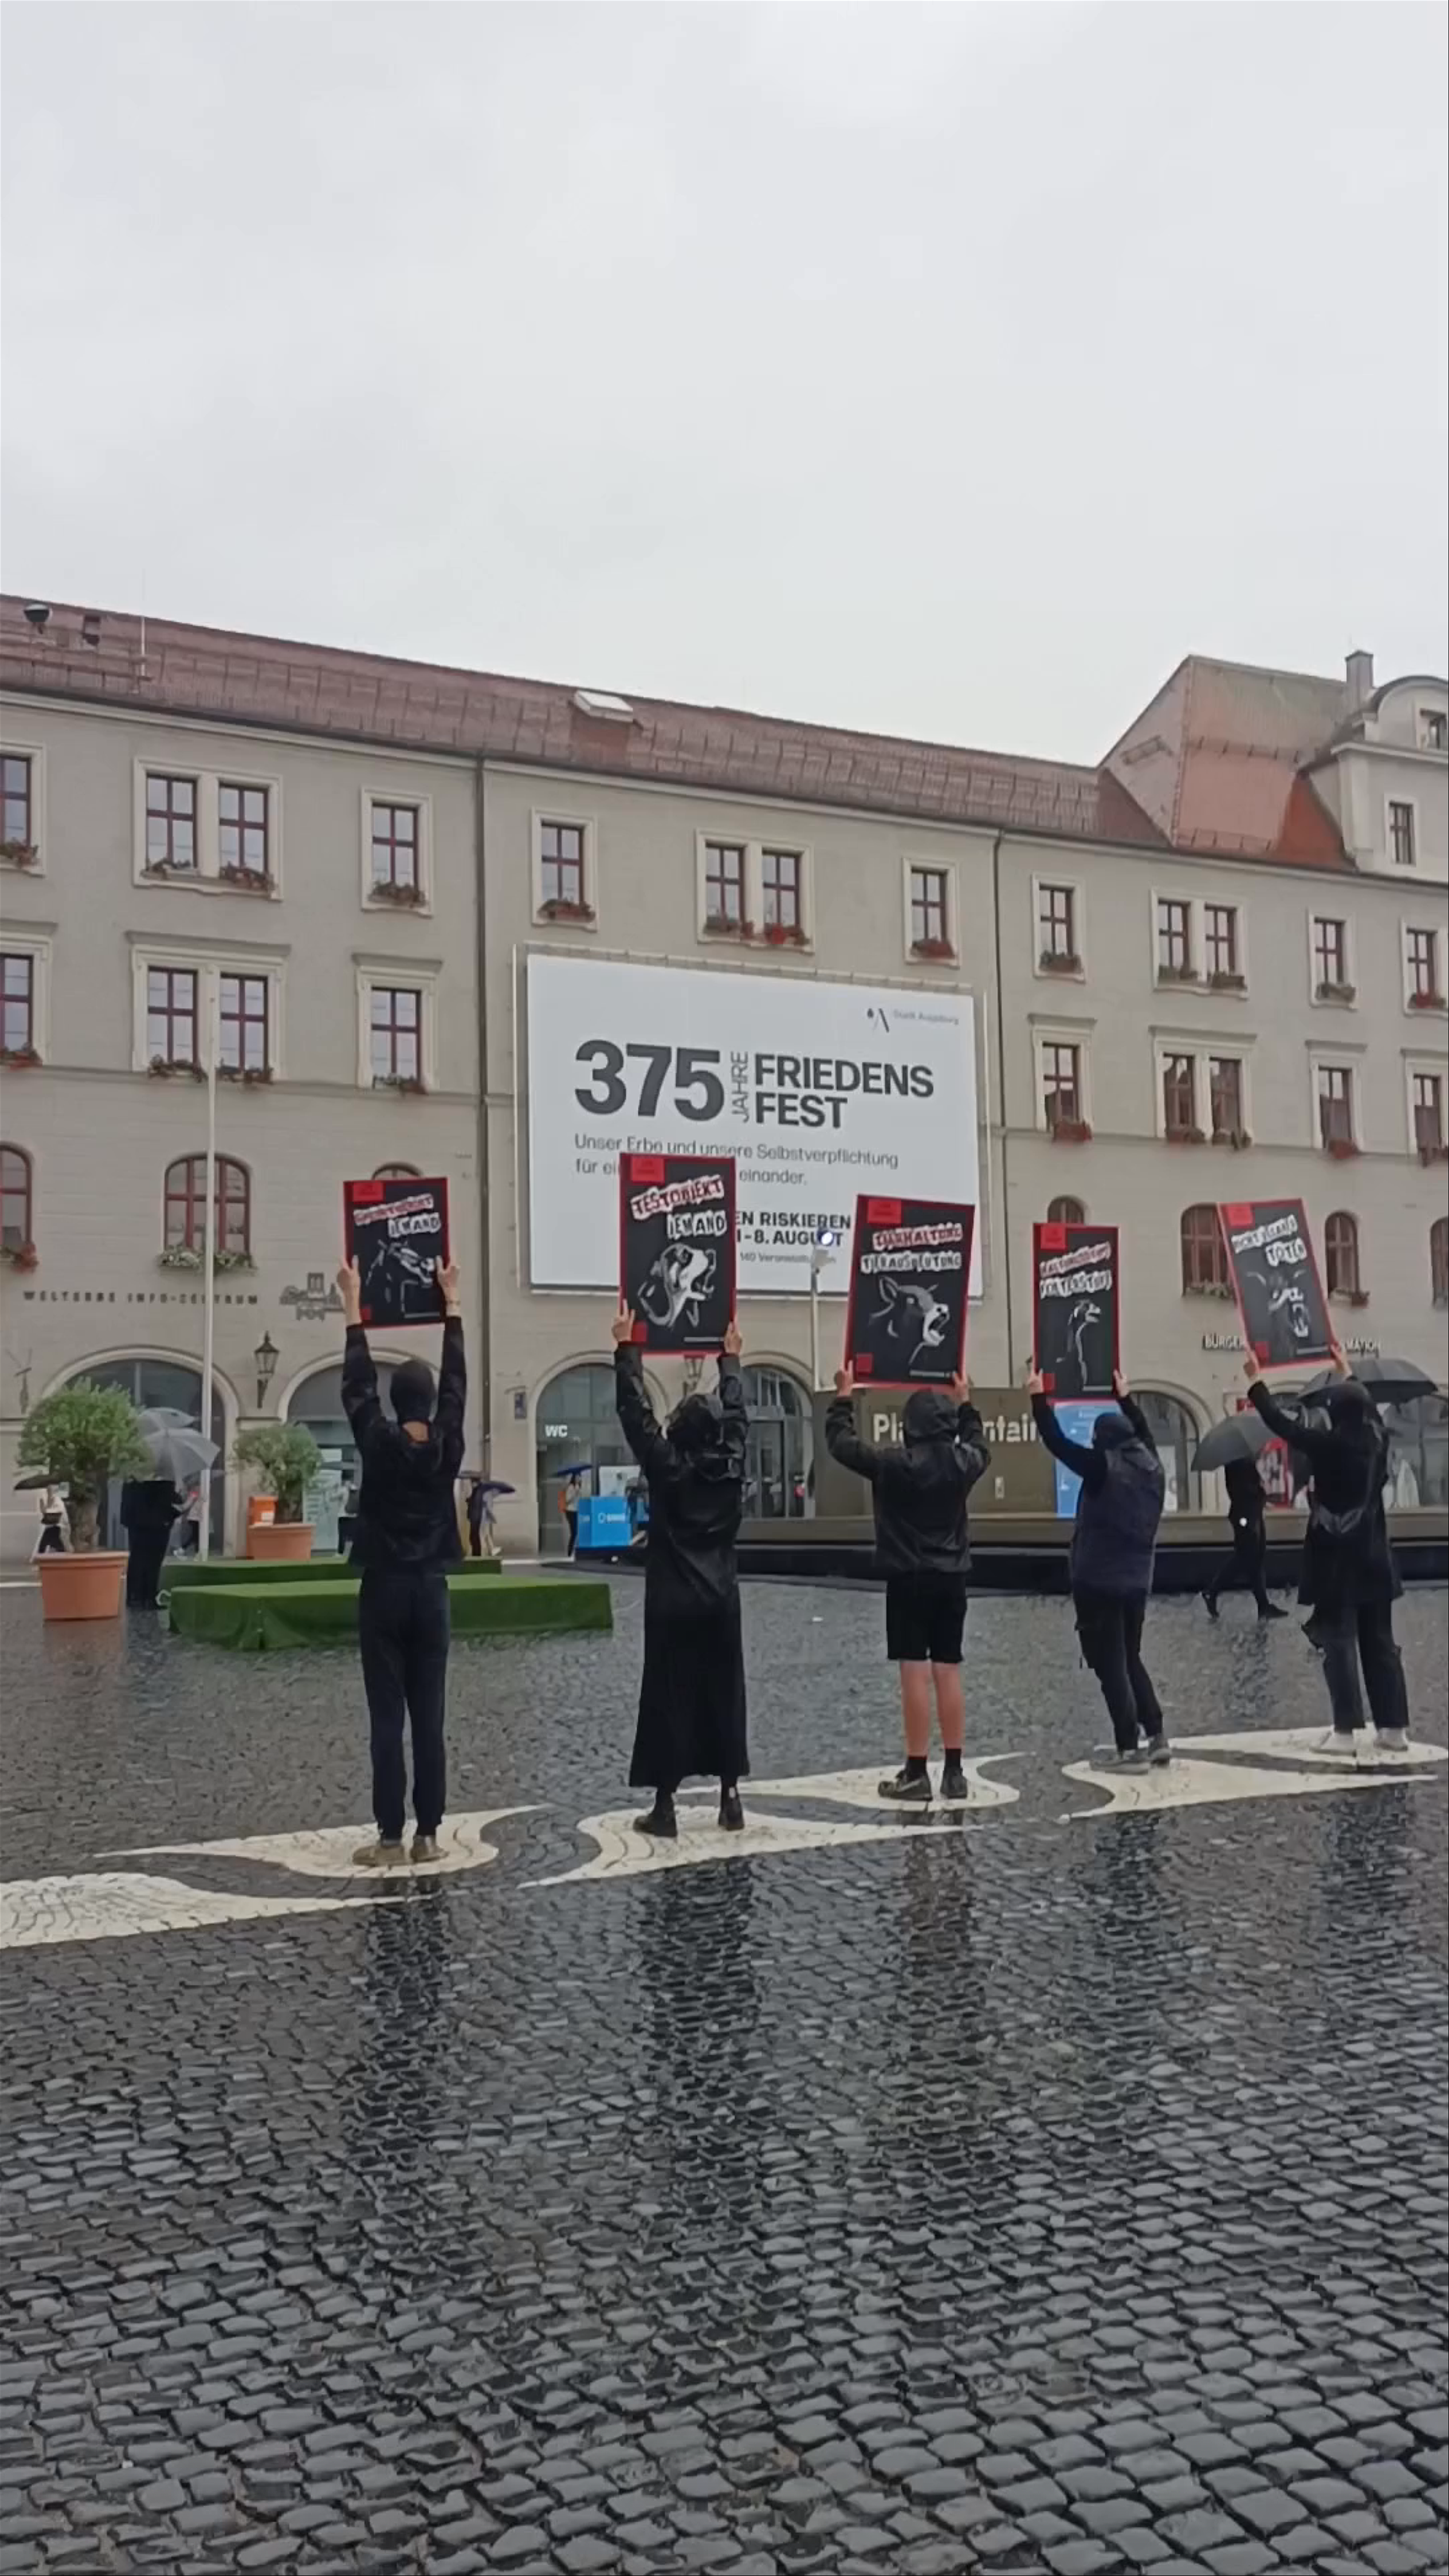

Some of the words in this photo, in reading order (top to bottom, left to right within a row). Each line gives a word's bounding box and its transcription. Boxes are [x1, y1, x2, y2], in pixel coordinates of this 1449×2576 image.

[575, 1040, 724, 1121] 375
[731, 1051, 749, 1123] JAHRE
[755, 1053, 934, 1098] FRIEDENS
[755, 1091, 848, 1129] FEST
[575, 1133, 622, 1150] Unser
[627, 1136, 663, 1152] Erbe
[667, 1141, 696, 1155] und
[700, 1144, 753, 1159] unsere
[757, 1143, 898, 1169] Selbstverpflichtung
[576, 1158, 598, 1174] für
[739, 1169, 808, 1185] einander.
[631, 1175, 724, 1219] TESTOBJEKT
[667, 1210, 727, 1240] JEMAND
[760, 1212, 851, 1229] RISKIEREN
[773, 1230, 843, 1247] AUGUT
[545, 1424, 568, 1438] WC
